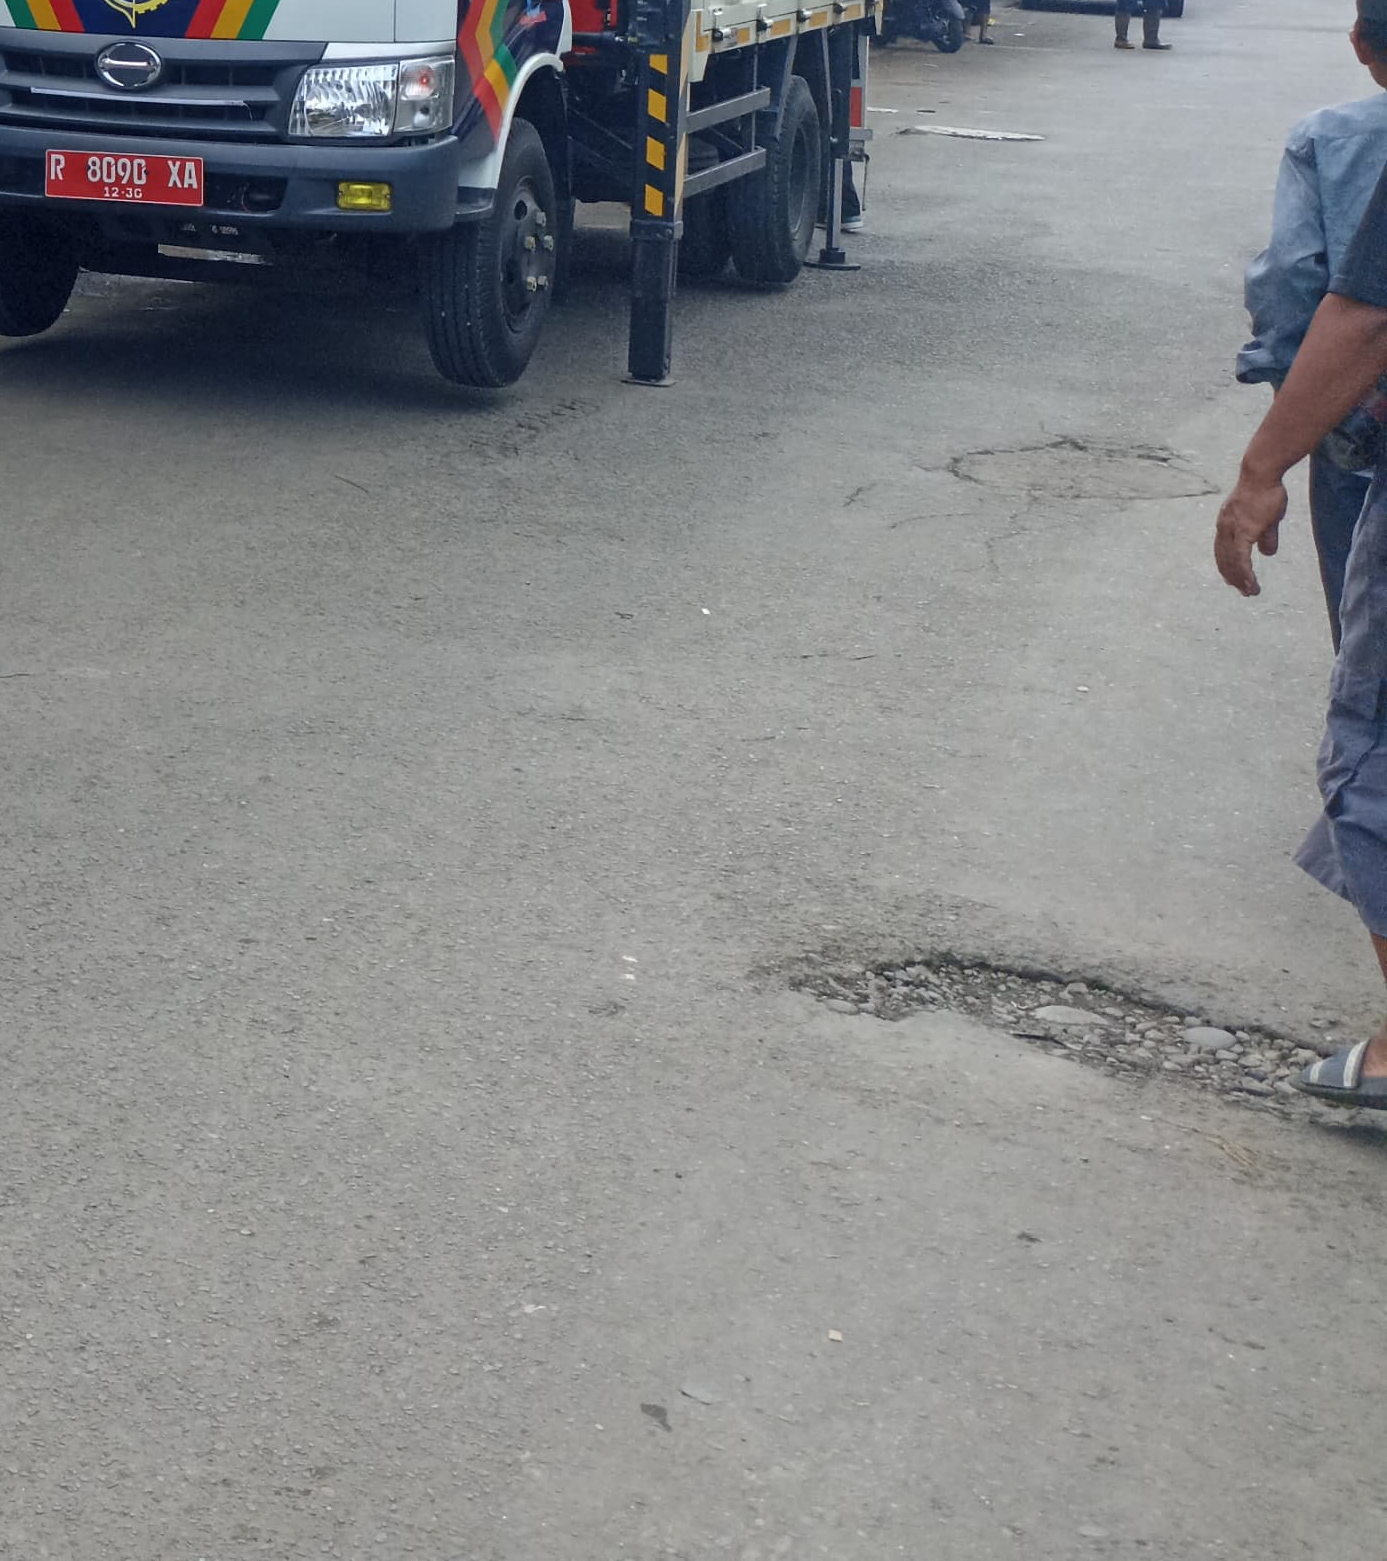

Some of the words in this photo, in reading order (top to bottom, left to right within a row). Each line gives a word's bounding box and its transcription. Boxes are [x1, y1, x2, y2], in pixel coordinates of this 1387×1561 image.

[50, 154, 66, 181] R
[87, 156, 147, 185] 8090
[167, 160, 198, 189] XA
